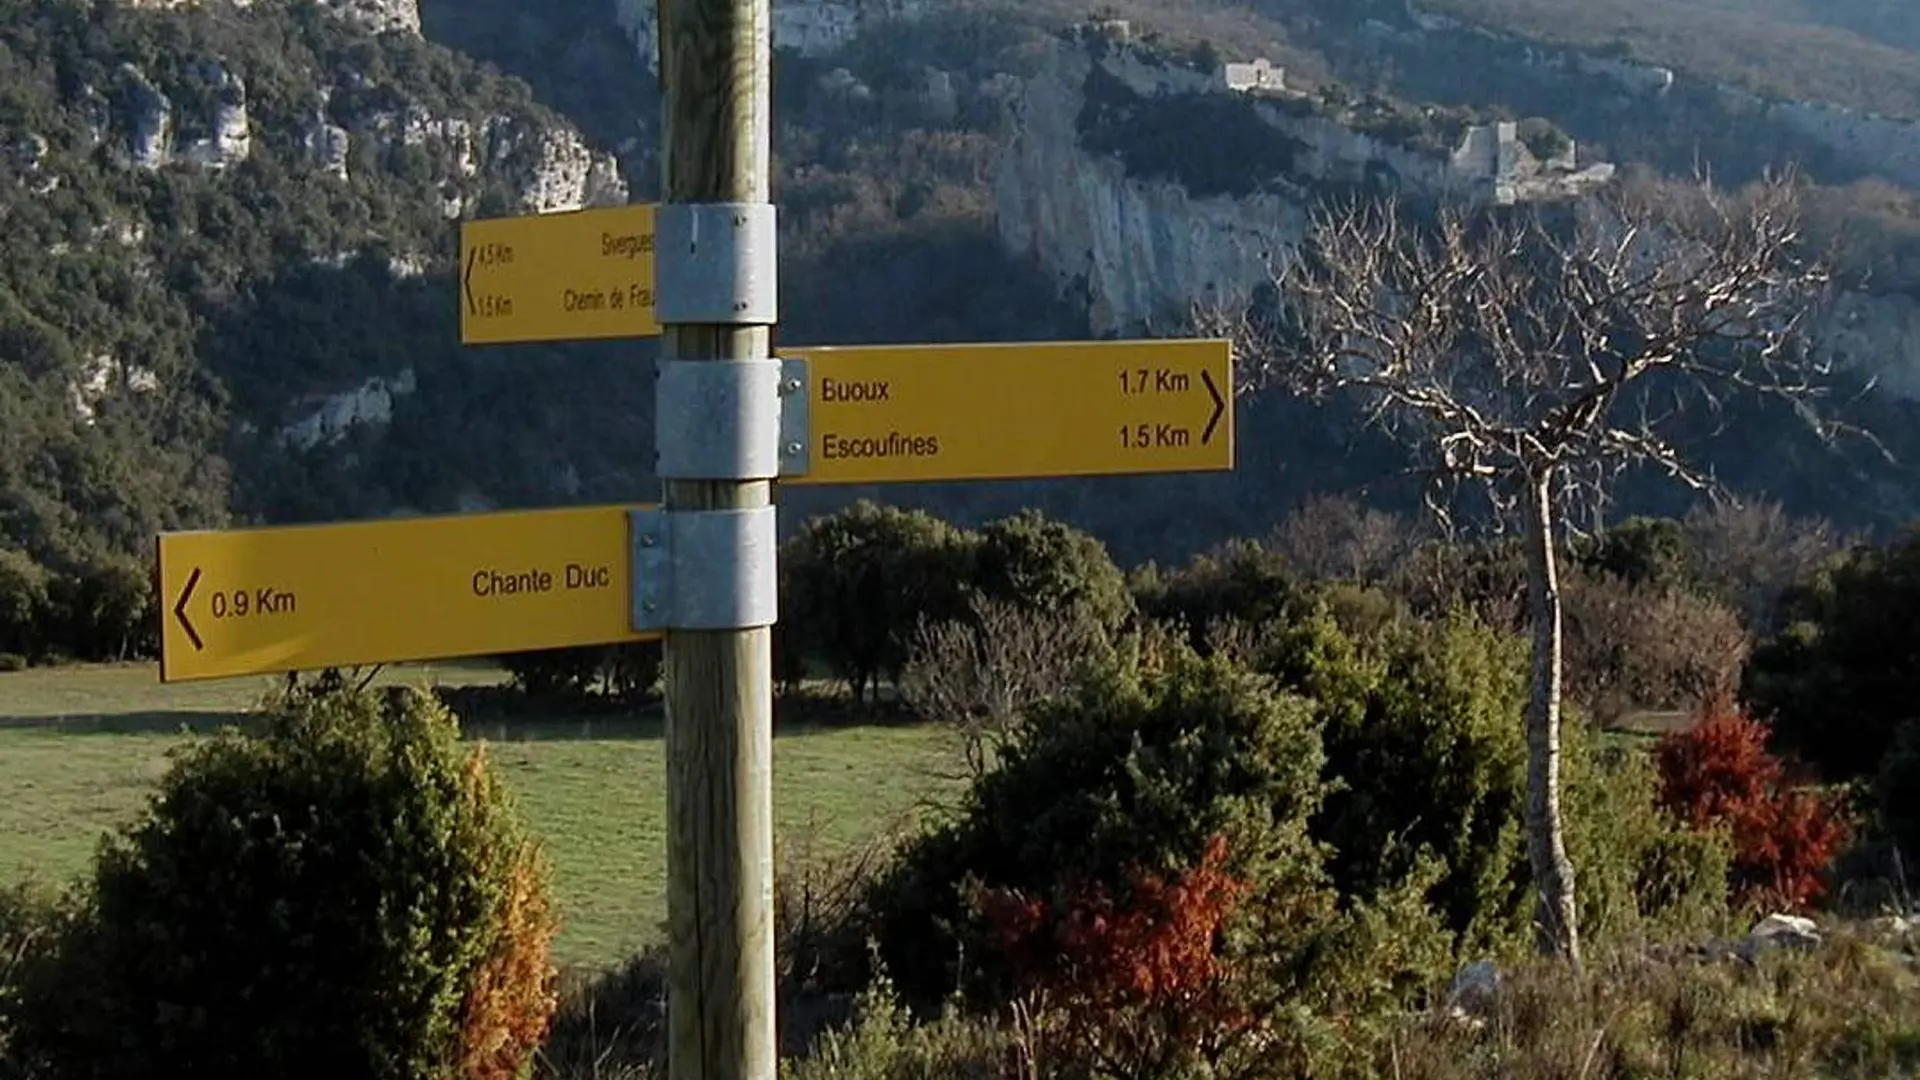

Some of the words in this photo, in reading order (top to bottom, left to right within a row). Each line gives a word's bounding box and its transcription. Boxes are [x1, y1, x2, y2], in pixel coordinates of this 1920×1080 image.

[563, 288, 605, 312] Chemin
[610, 286, 624, 310] de
[821, 377, 890, 404] Buoux
[1119, 370, 1147, 394] 1.7
[1155, 368, 1190, 393] Km
[821, 431, 939, 461] Escoufines
[1119, 425, 1147, 449] 1.5
[1155, 423, 1190, 448] Km
[472, 567, 552, 598] Chante
[565, 562, 610, 590] Duc
[211, 590, 250, 619] 0.9
[256, 586, 296, 616] Km
